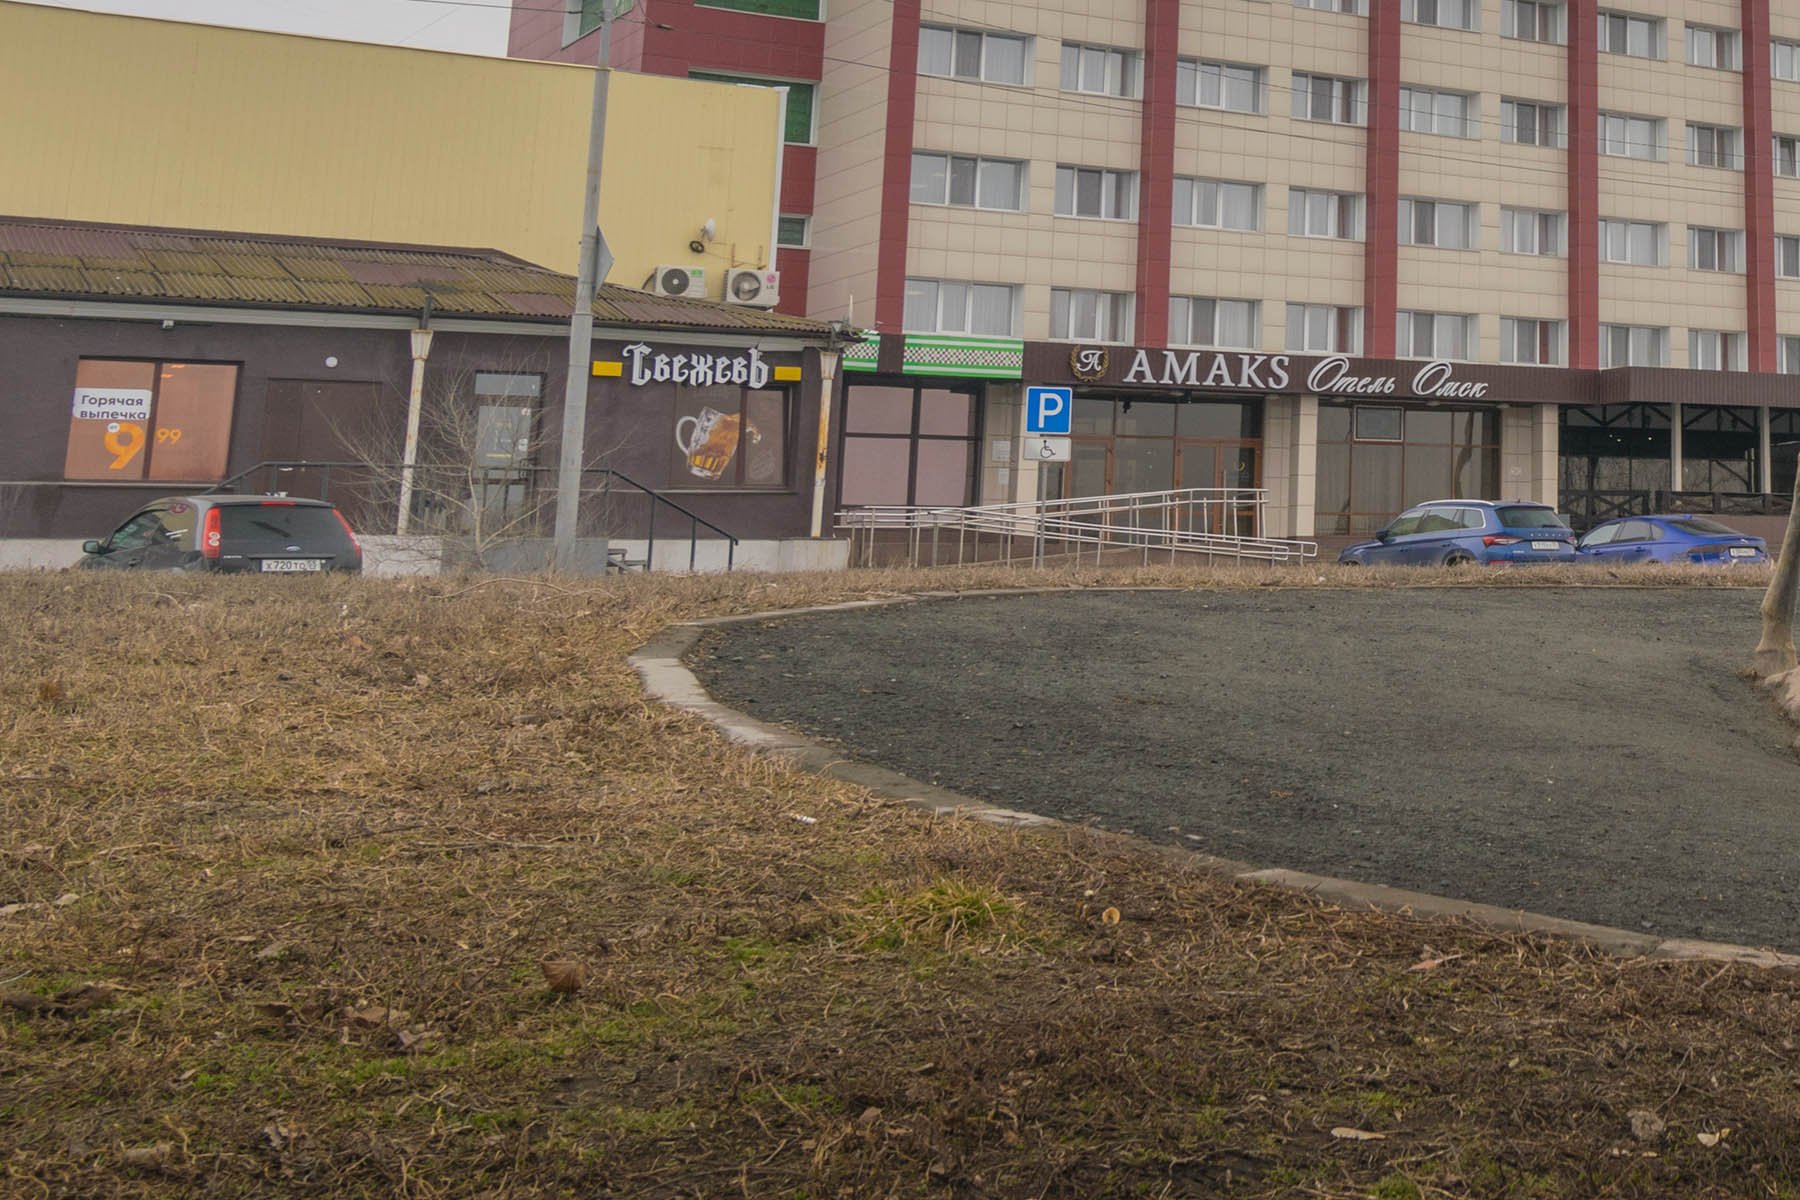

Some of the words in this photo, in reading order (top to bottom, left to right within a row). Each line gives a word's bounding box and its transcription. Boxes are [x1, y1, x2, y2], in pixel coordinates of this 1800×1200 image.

[1123, 349, 1289, 389] AMAKS
[1307, 355, 1396, 394] Отель
[1412, 361, 1489, 398] Омск
[80, 410, 147, 420] выпечка
[81, 394, 144, 408] Горячая
[1038, 393, 1063, 429] P
[104, 422, 144, 470] 9
[156, 428, 182, 444] 99
